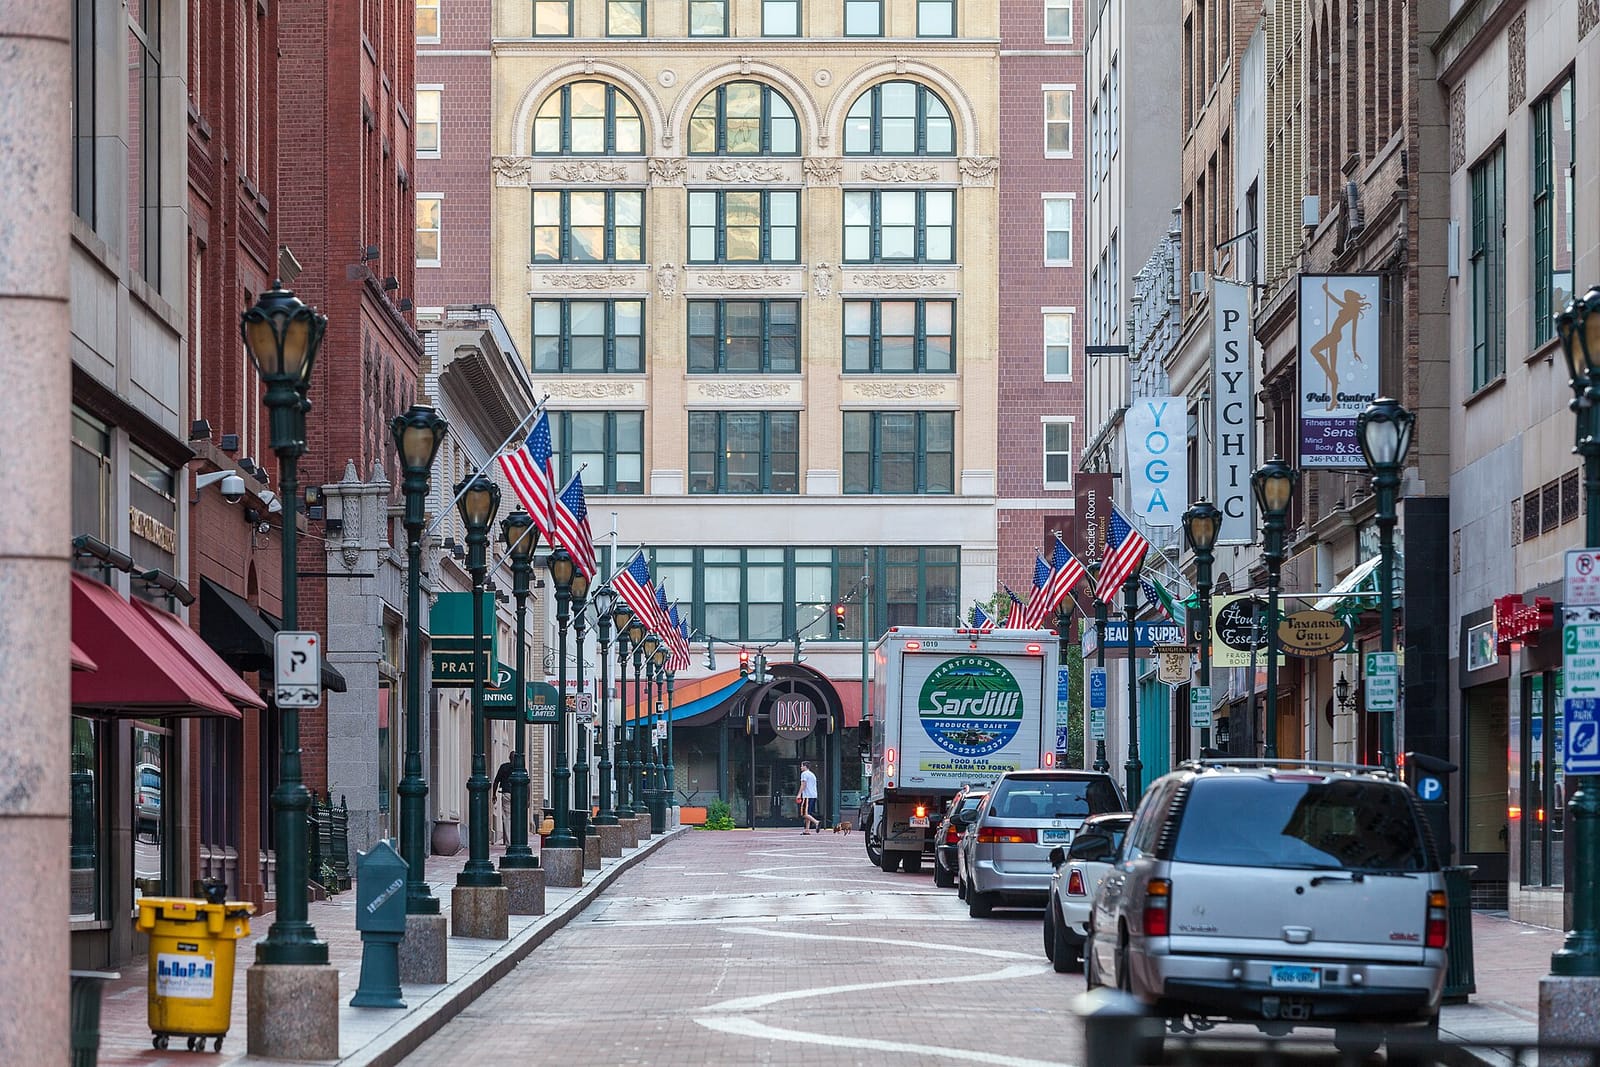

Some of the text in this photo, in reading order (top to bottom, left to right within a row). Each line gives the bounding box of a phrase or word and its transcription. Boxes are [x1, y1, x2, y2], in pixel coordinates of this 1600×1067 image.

[1221, 309, 1245, 518] PSYCHIC
[1145, 402, 1170, 512] YOGA
[1335, 442, 1346, 453] &
[1086, 490, 1096, 520] Room
[1086, 521, 1098, 557] Society
[1296, 630, 1330, 641] GRILL
[1568, 631, 1576, 649] 2
[1368, 658, 1375, 672] 2
[777, 700, 811, 728] DISH
[920, 691, 1020, 717] Sardilli
[1424, 778, 1440, 799] P
